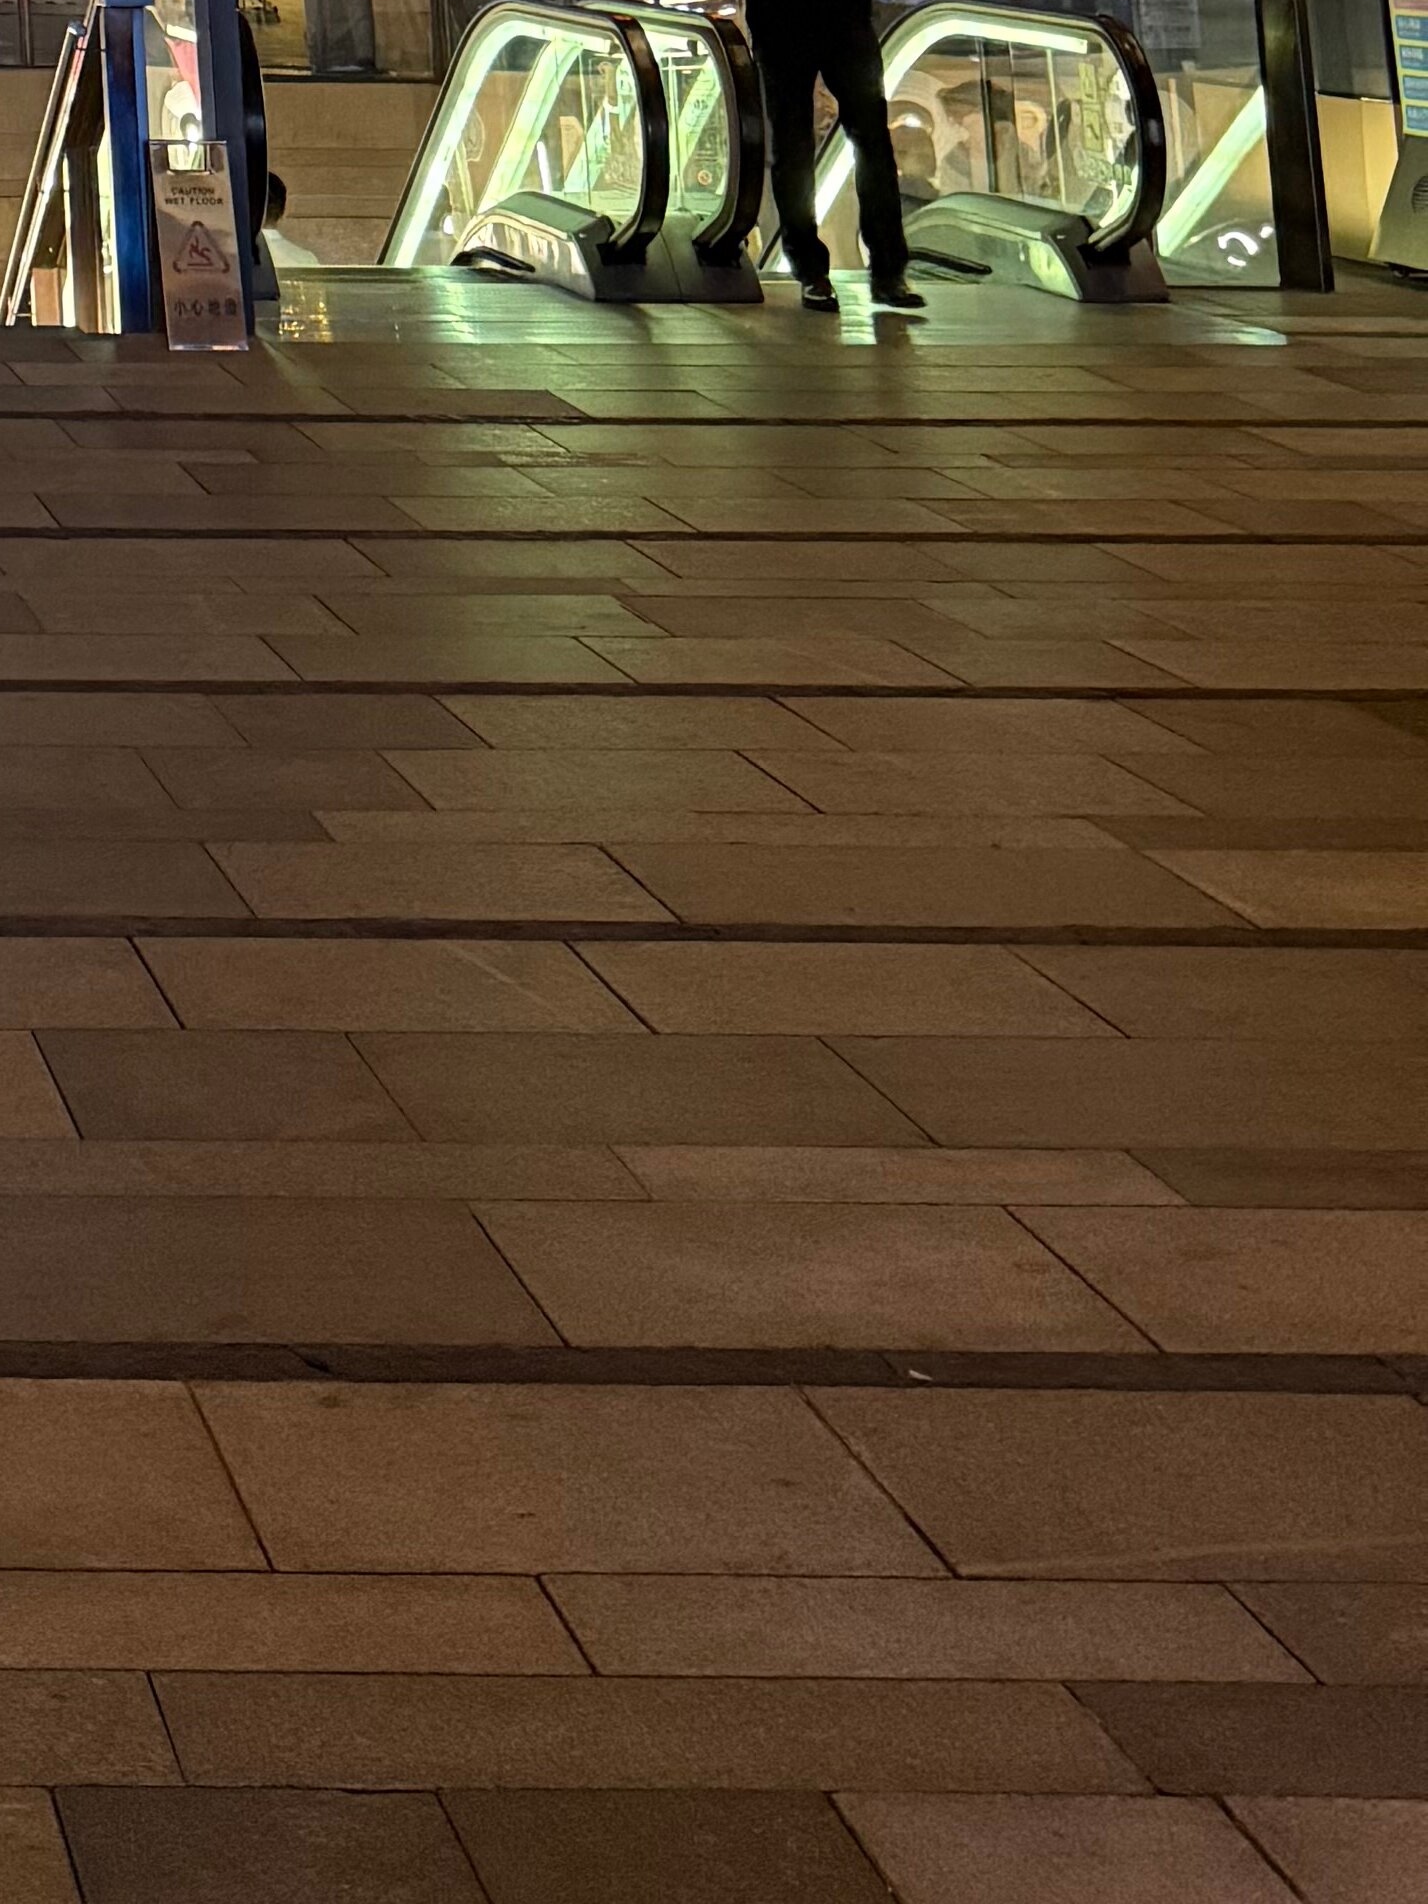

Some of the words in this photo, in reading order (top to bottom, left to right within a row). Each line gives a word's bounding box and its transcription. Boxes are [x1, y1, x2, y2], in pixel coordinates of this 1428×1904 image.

[170, 186, 215, 196] CAUTION
[164, 197, 185, 206] WET
[190, 197, 224, 206] FLOOR
